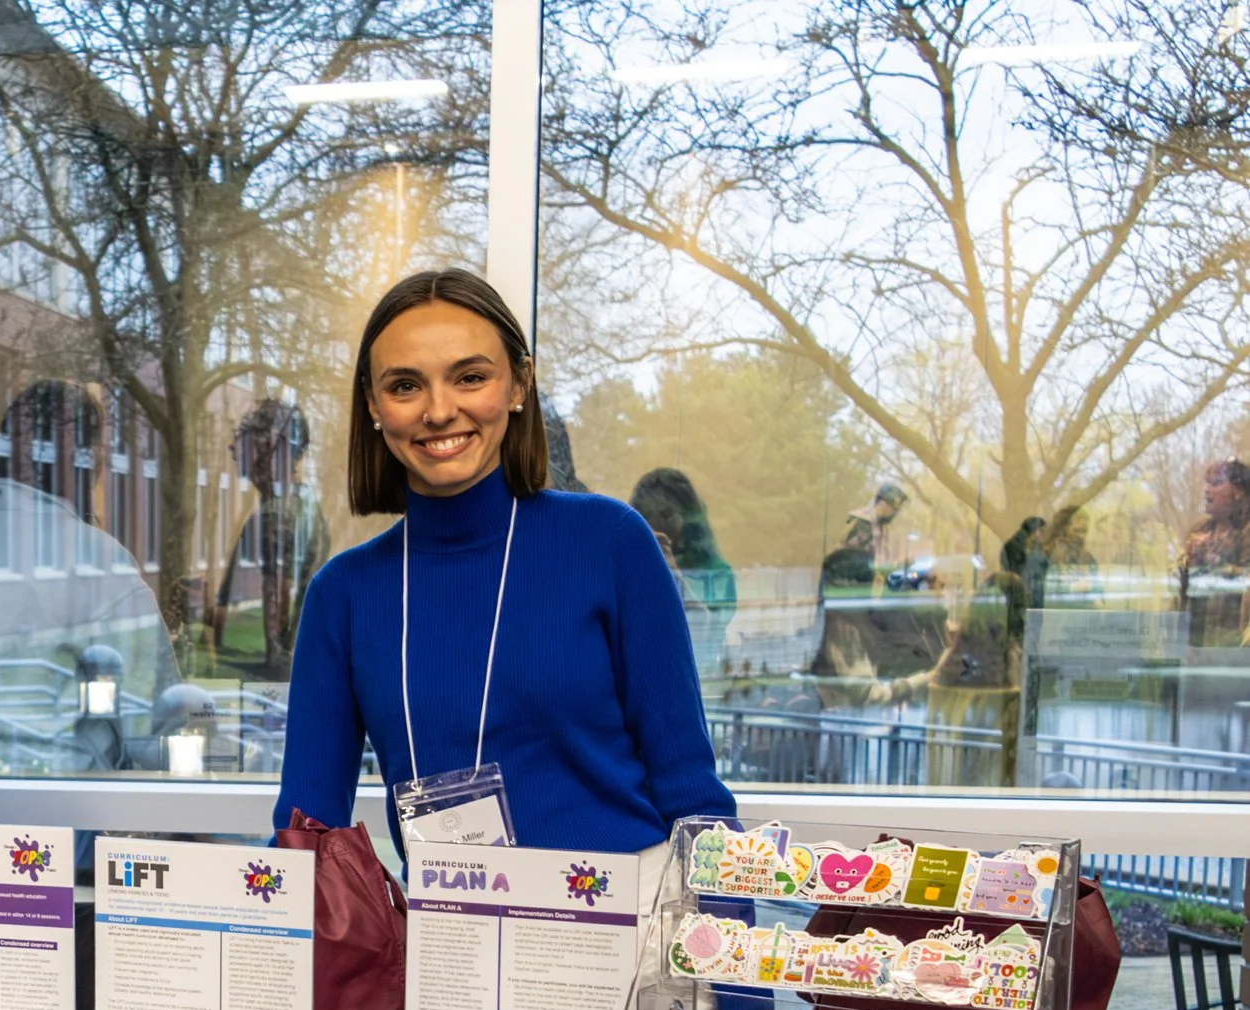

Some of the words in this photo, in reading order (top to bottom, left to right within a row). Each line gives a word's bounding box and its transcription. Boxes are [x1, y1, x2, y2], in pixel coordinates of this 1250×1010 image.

[461, 830, 486, 844] Miller
[422, 860, 488, 870] CURRICULUM:
[736, 856, 755, 865] YOU
[108, 860, 170, 890] LiFT
[742, 866, 768, 876] YOUR
[422, 870, 487, 891] PLAN
[491, 872, 510, 893] A
[735, 876, 774, 886] BIGGEST
[724, 883, 782, 896] SUPPORTER
[815, 893, 847, 902] deserve
[421, 902, 440, 910] About
[508, 908, 554, 919] Implementation
[554, 912, 576, 920] Details
[229, 925, 262, 934] Condensed
[0, 940, 27, 948] Condensed
[984, 962, 1038, 980] COOL!
[1002, 979, 1014, 988] IS
[973, 995, 990, 1006] TO
